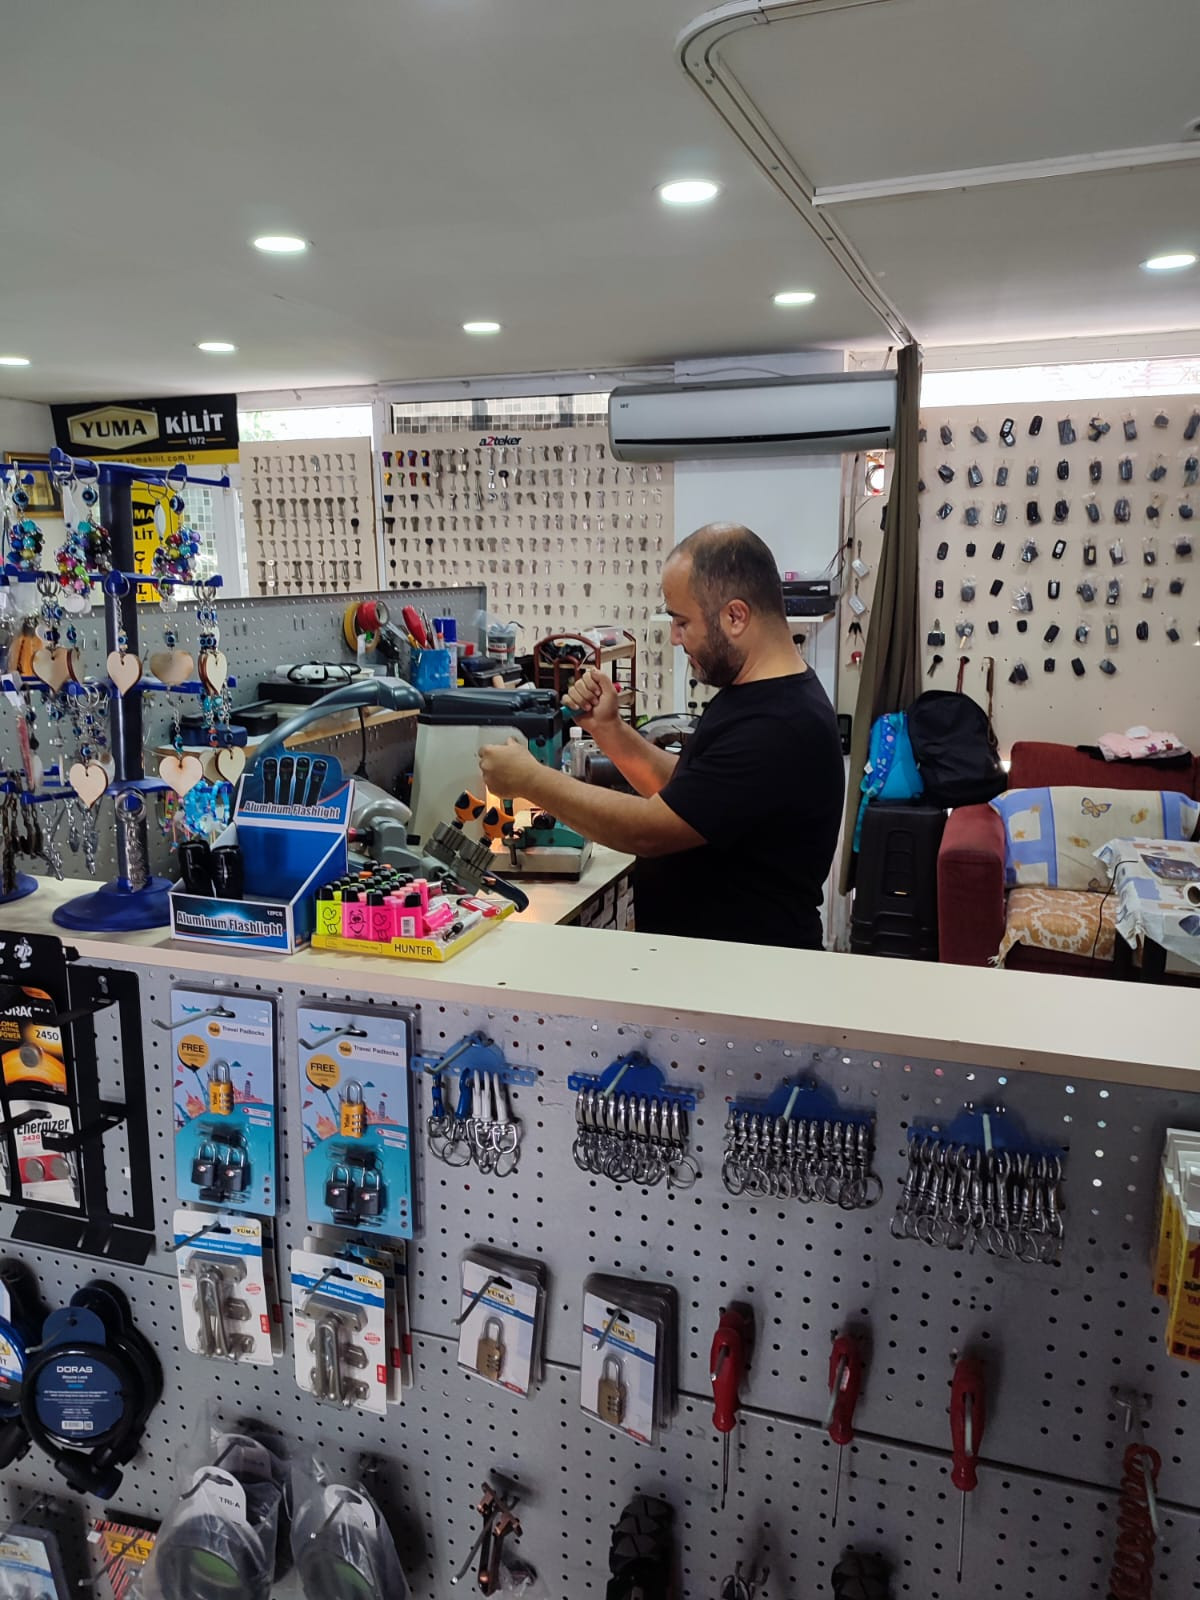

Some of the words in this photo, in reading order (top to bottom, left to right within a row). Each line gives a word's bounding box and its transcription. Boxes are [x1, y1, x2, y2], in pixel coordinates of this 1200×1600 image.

[80, 419, 147, 438] YUMA
[165, 410, 223, 434] KİLİT
[187, 437, 206, 445] 1972
[134, 509, 154, 519] MA
[134, 527, 154, 540] LİT
[243, 800, 291, 815] Aluminum
[292, 803, 341, 820] Flashlight
[176, 911, 227, 930] Aluminum
[228, 919, 283, 937] Flashlight
[394, 943, 433, 956] HUNTER
[35, 1029, 60, 1041] 2450
[181, 1042, 205, 1054] FREE
[310, 1062, 336, 1074] FREE
[236, 1228, 256, 1236] YUMA
[357, 1277, 379, 1288] YUMA
[486, 1288, 512, 1303] YUMA
[56, 1366, 93, 1374] DORAS
[219, 1496, 241, 1510] TRI-A
